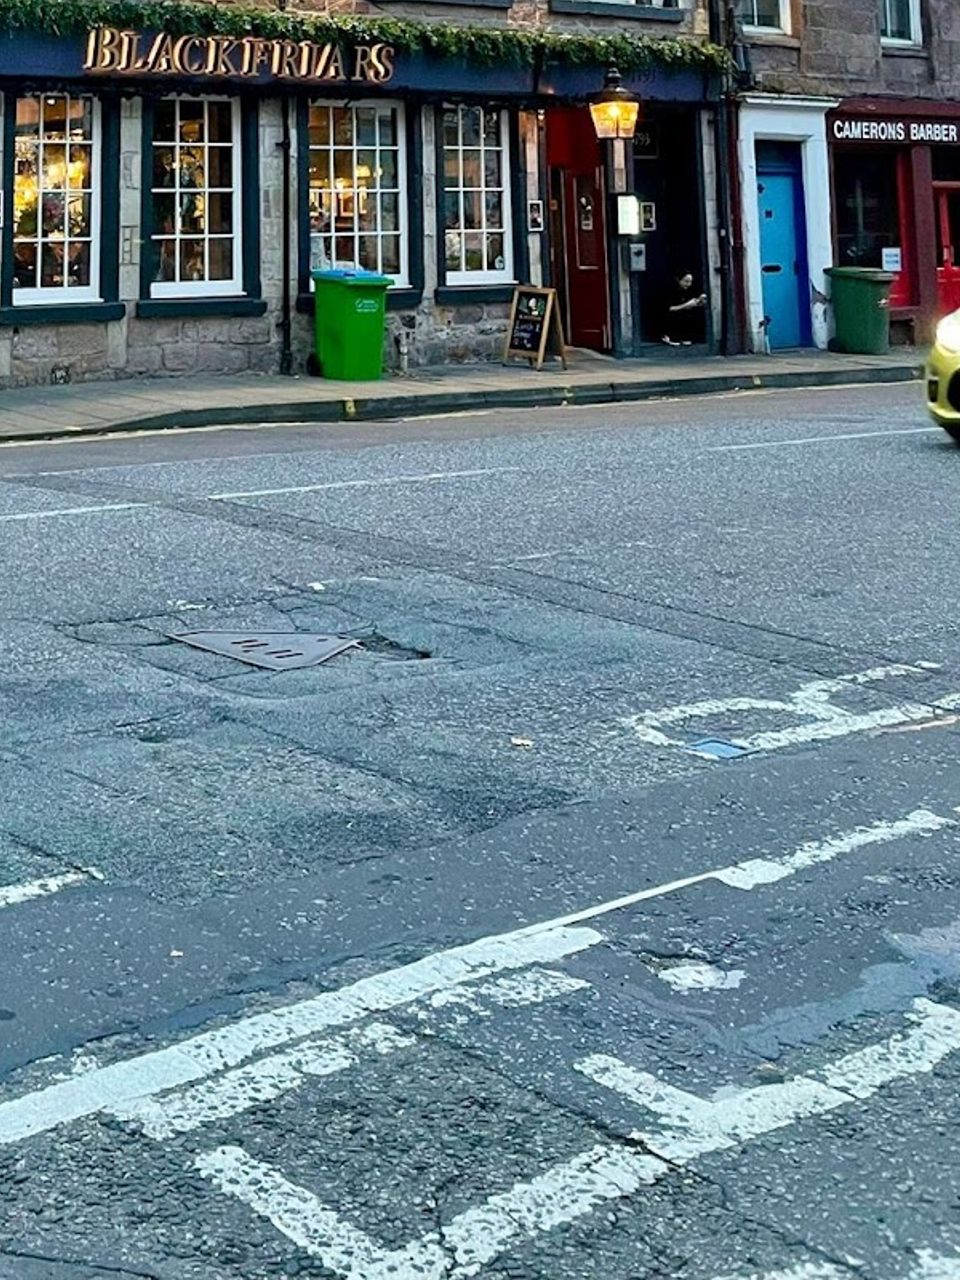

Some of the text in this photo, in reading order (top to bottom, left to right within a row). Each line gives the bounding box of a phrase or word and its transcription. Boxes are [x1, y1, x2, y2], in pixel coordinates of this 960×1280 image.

[83, 25, 395, 84] BLACKFRIARS
[833, 120, 958, 141] CAMERONS BARBER
